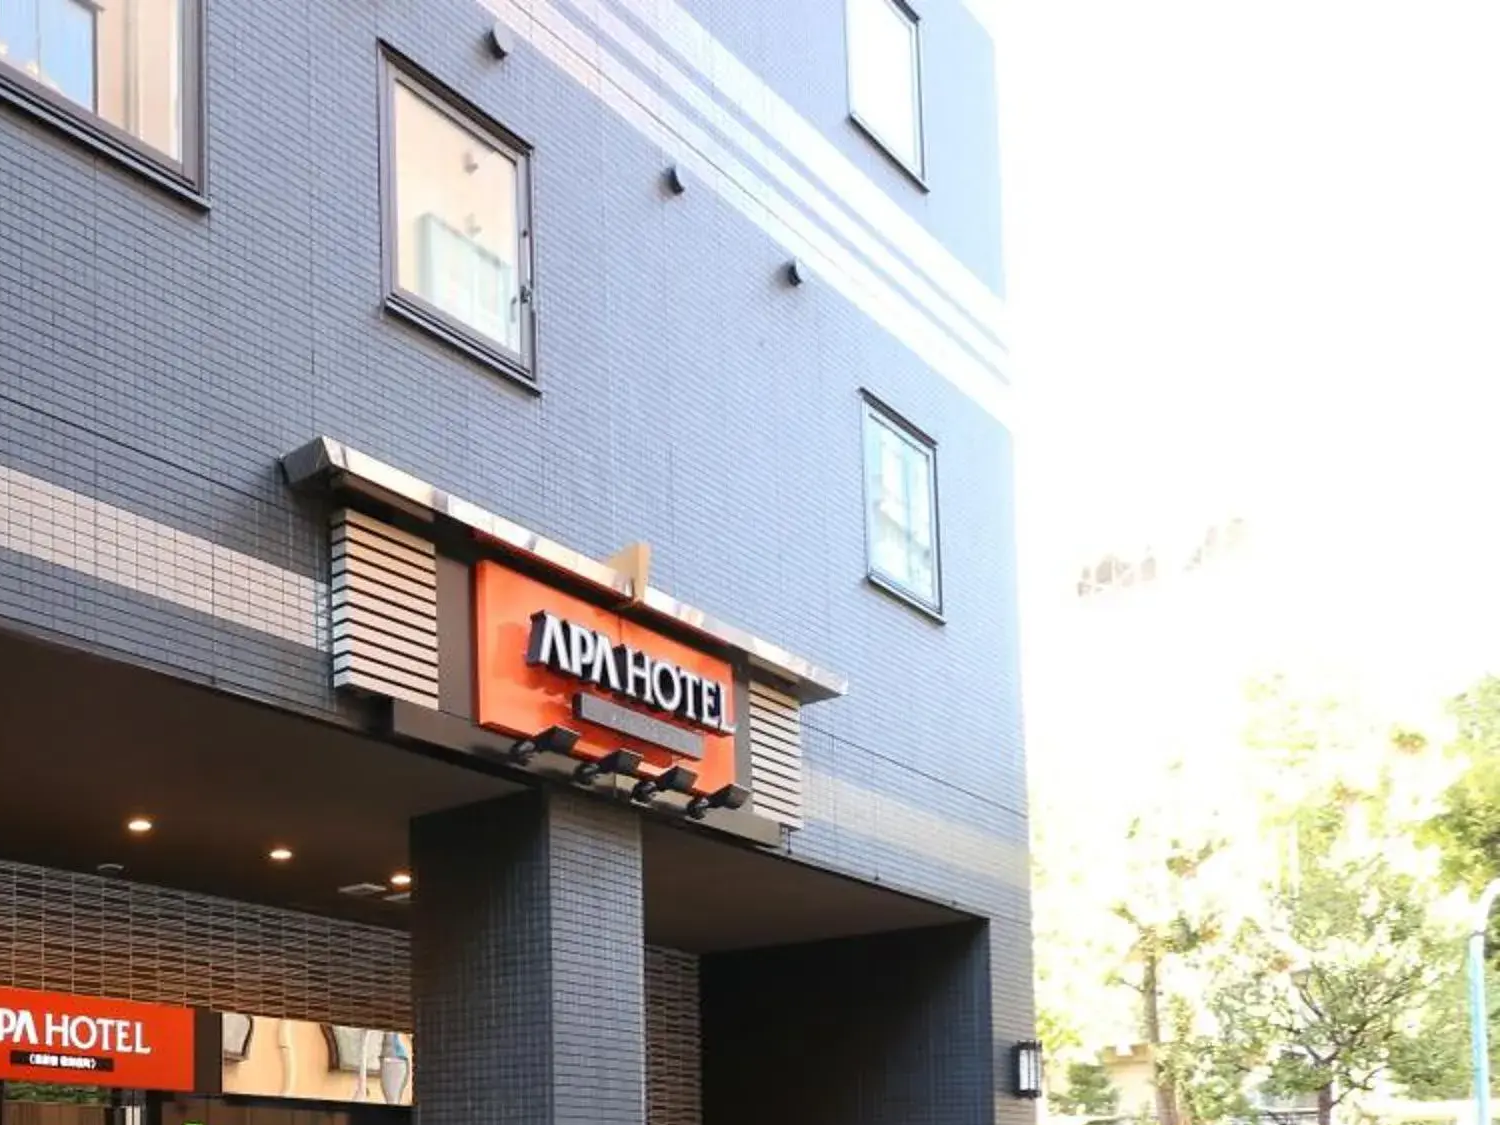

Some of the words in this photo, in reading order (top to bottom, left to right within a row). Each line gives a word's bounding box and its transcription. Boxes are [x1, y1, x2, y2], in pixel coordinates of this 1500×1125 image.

[538, 611, 622, 690] APA
[625, 646, 737, 731] HOTEL
[44, 1013, 151, 1055] HOTEL
